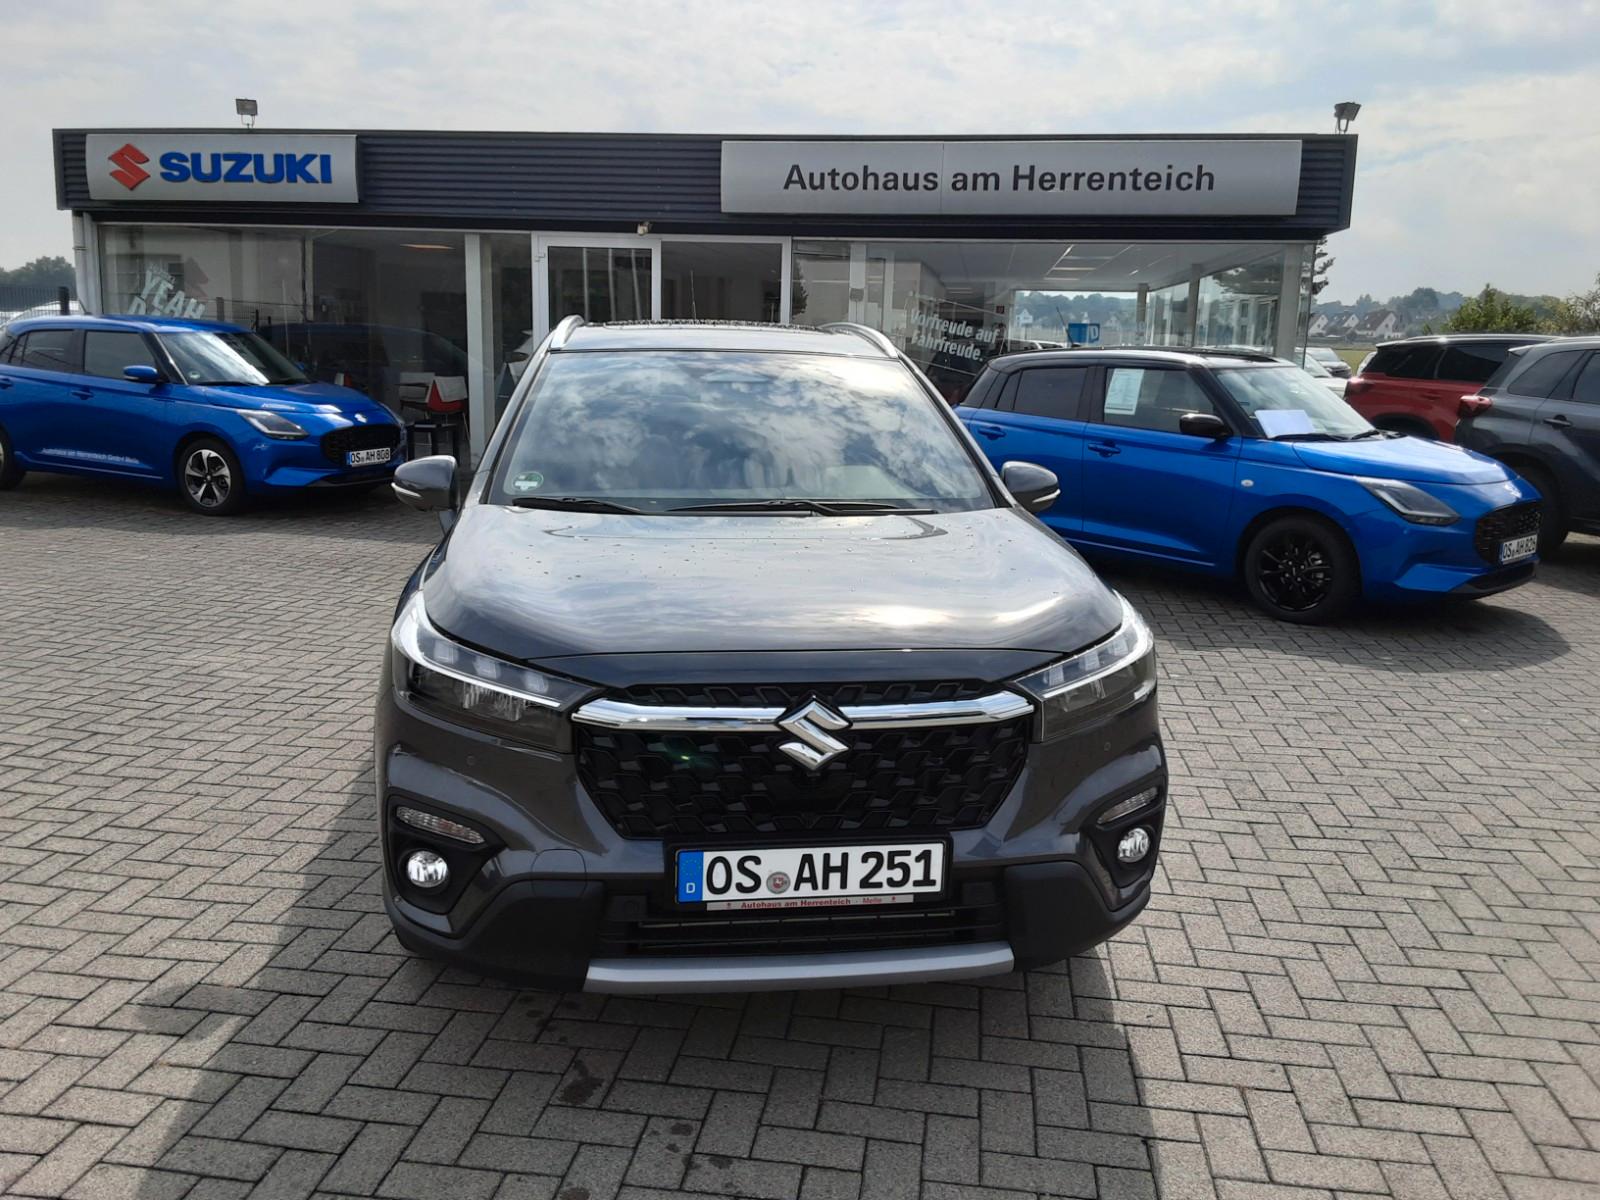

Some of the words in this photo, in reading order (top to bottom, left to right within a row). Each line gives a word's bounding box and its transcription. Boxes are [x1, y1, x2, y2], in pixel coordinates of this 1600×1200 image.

[159, 151, 332, 184] SUZUKI
[783, 164, 939, 192] Autohaus
[951, 171, 1001, 192] am
[1013, 163, 1216, 192] Herrenteich
[911, 308, 973, 337] Vorfreude
[976, 328, 1000, 344] auf
[911, 330, 983, 361] Fahrfreude.
[686, 882, 696, 894] D
[706, 855, 762, 895] OS
[794, 852, 849, 891] AH
[859, 849, 937, 889] 251
[741, 901, 781, 909] Autohaus
[800, 898, 851, 908] Herrenteich
